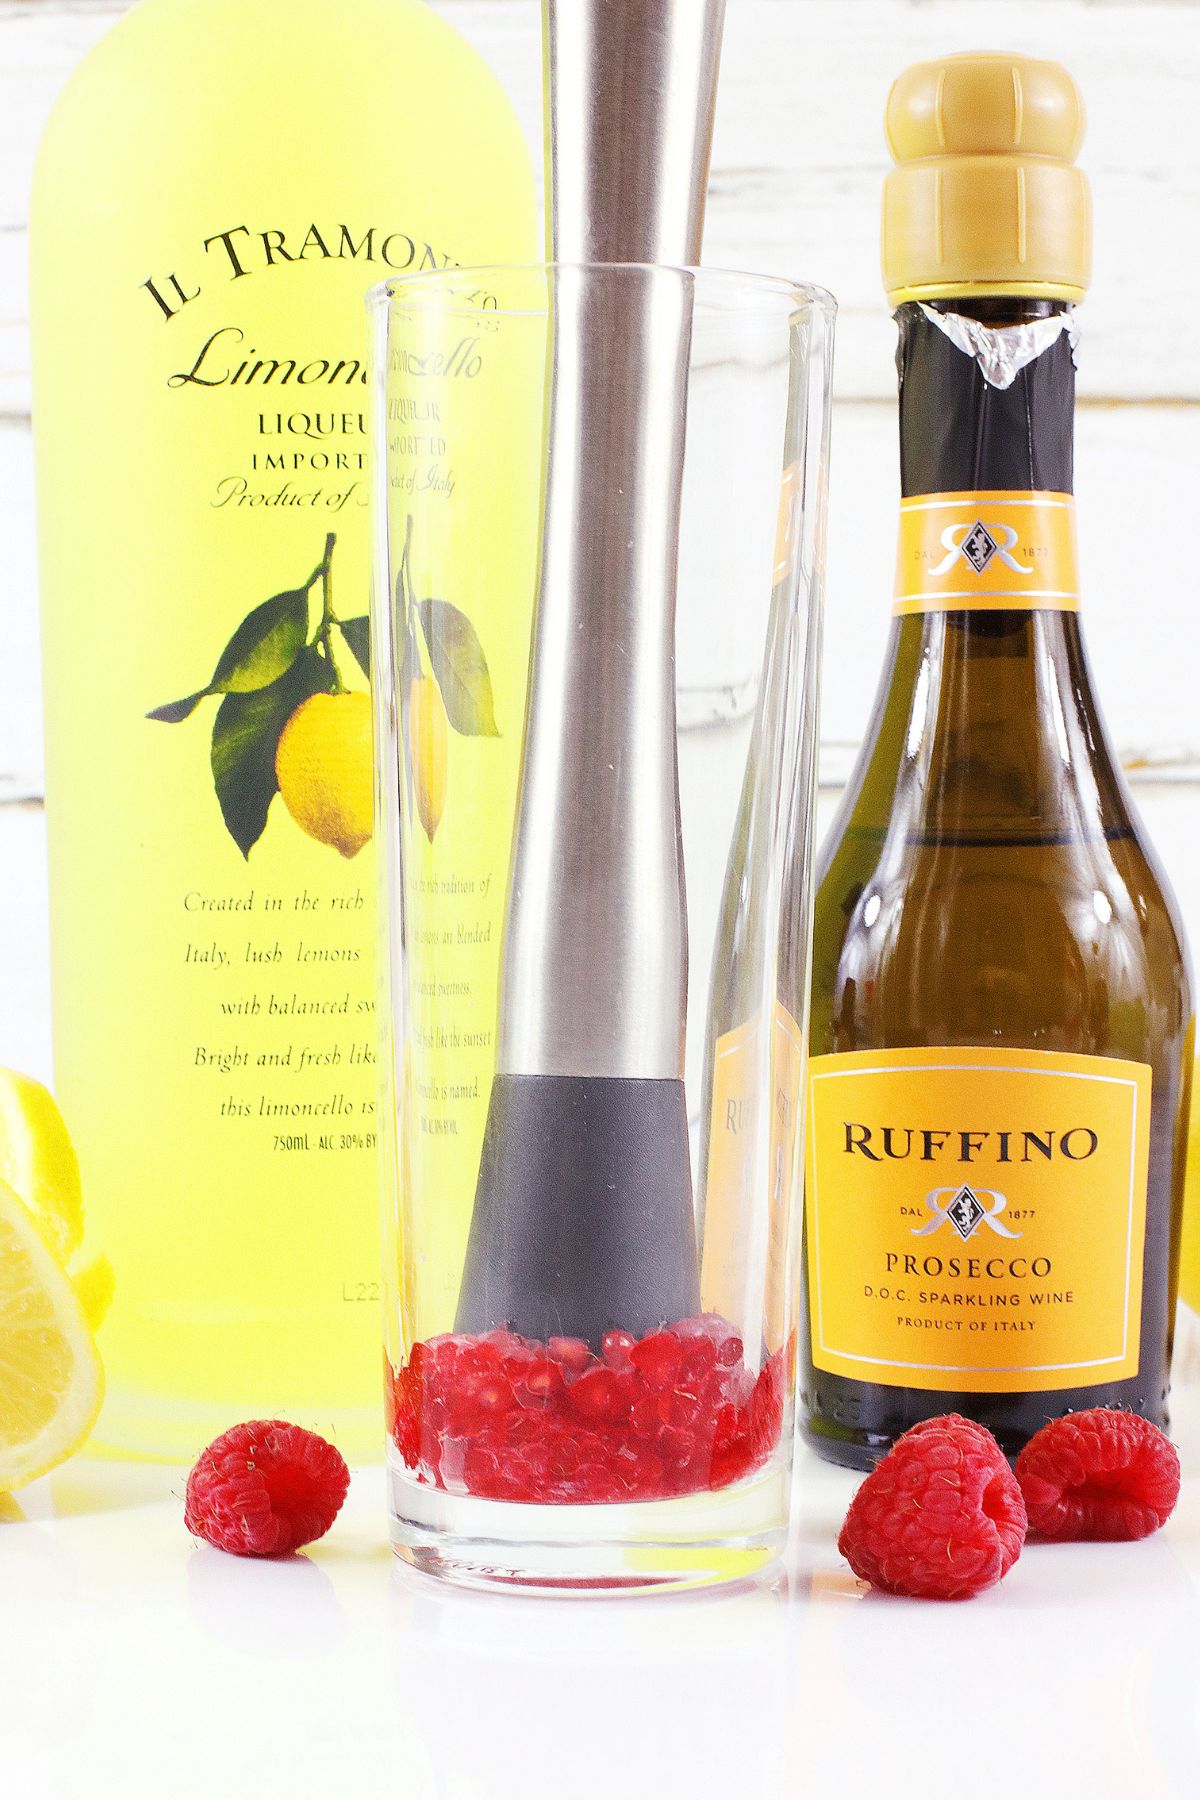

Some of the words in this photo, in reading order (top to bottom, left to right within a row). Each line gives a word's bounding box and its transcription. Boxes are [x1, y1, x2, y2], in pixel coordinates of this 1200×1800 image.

[139, 271, 202, 322] IL
[210, 475, 321, 509] Product
[324, 481, 360, 513] of
[184, 890, 254, 911] Created
[263, 892, 284, 912] in
[294, 889, 319, 911] the
[331, 889, 364, 910] rich
[184, 942, 231, 970] Italy,
[245, 942, 282, 963] lush
[297, 941, 360, 962] lemons
[221, 994, 261, 1015] with
[268, 993, 350, 1015] balanced
[194, 1045, 249, 1073] Bright
[256, 1045, 293, 1066] and
[295, 1043, 342, 1073] fresh
[220, 1095, 251, 1117] this
[259, 1094, 353, 1116] limoncello
[340, 1134, 363, 1150] 30%
[843, 1122, 1098, 1163] RUFFINO
[900, 1206, 923, 1217] DAL
[1008, 1210, 1036, 1220] 1877
[886, 1252, 1052, 1279] PROSECCO
[864, 1285, 911, 1302] D.O.C.
[919, 1291, 1020, 1307] SPARKLING
[1029, 1291, 1073, 1305] WINE
[897, 1316, 963, 1331] PRODUCT
[968, 1319, 988, 1332] OF
[993, 1319, 1036, 1332] ITALY
